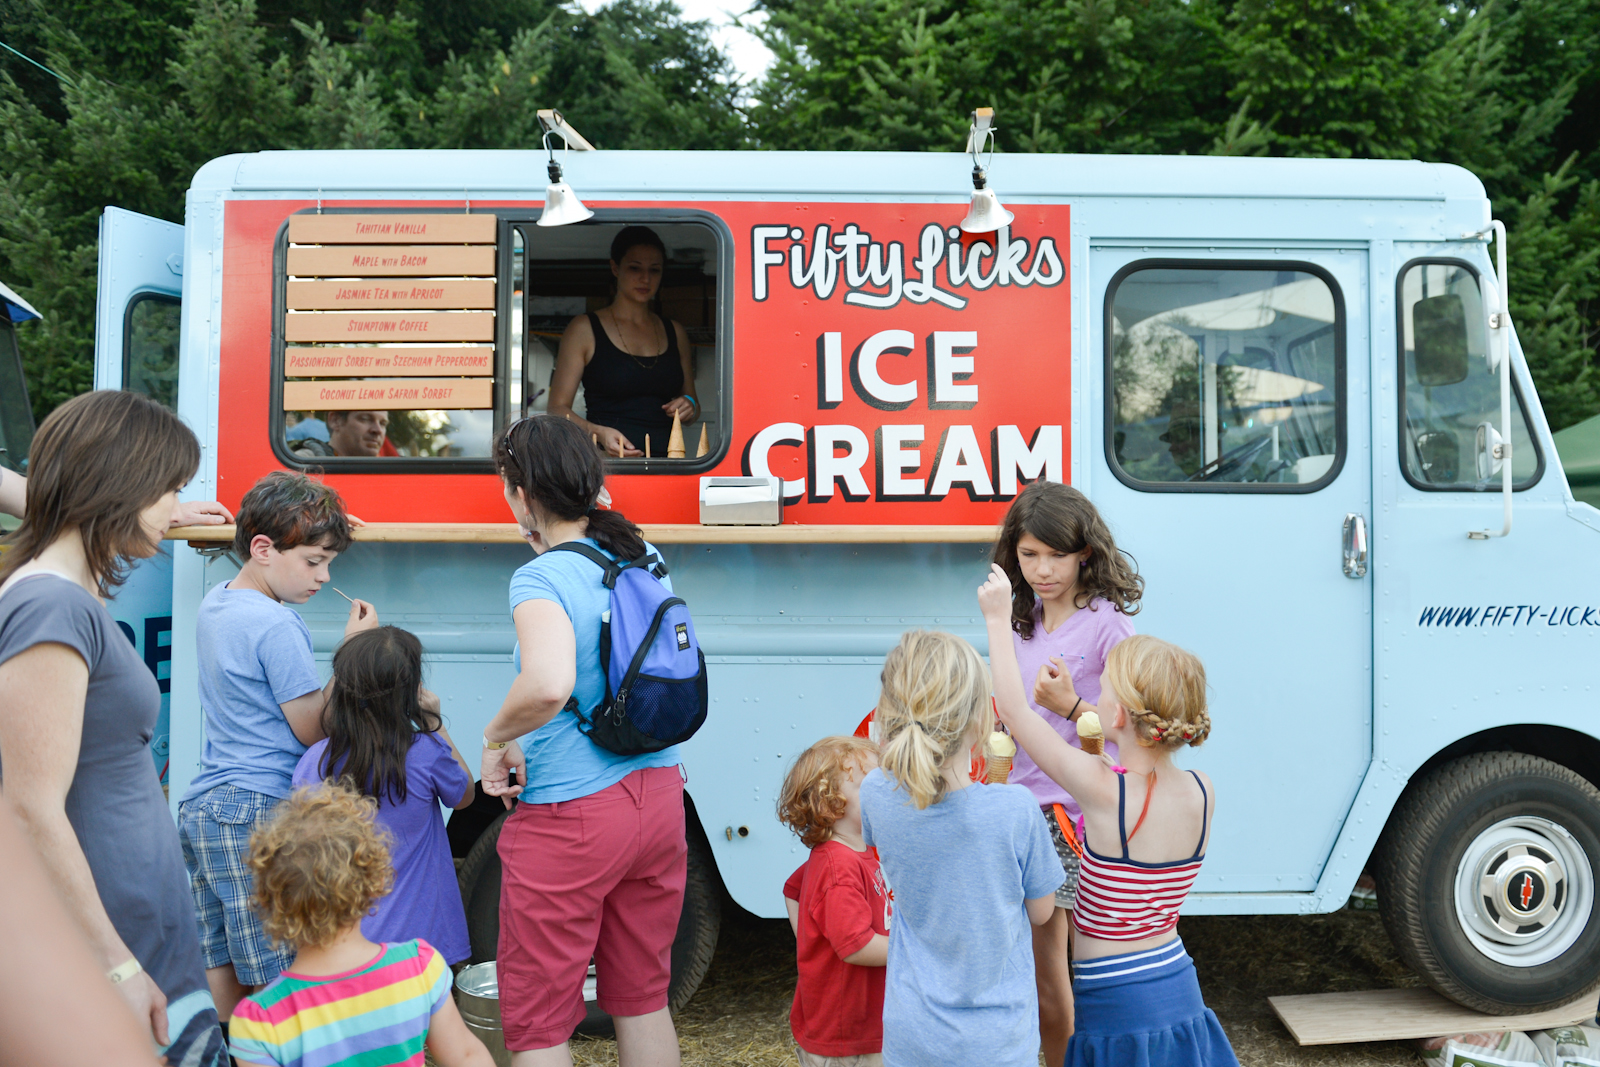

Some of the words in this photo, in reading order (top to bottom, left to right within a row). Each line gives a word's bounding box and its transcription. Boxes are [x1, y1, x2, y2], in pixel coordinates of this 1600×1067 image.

[355, 222, 392, 235] TAHITIAN
[393, 222, 427, 235] VANILLA
[352, 255, 379, 267] MAPLE
[381, 257, 398, 267] WITH
[400, 255, 428, 267] BACON
[751, 223, 904, 309] Fifty
[902, 223, 1065, 310] Licks
[335, 287, 373, 300] JASMINE
[374, 287, 390, 300] TEA
[392, 290, 408, 299] WITH
[410, 287, 444, 300] APRICOT
[347, 319, 396, 332] STUMPTOWN
[399, 319, 429, 332] COFFEE
[289, 355, 343, 368] PASSIONFRUIT
[344, 355, 374, 367] SORBET
[375, 358, 390, 367] WITH
[392, 354, 433, 367] SZECHUAN
[434, 354, 488, 367] PEPPERCORNS
[817, 329, 979, 410] ICE
[320, 388, 356, 400] COCONUT
[358, 387, 385, 400] LEMON
[387, 387, 419, 400] SAFRON
[421, 386, 453, 399] SORBET
[741, 422, 1063, 502] CREAM
